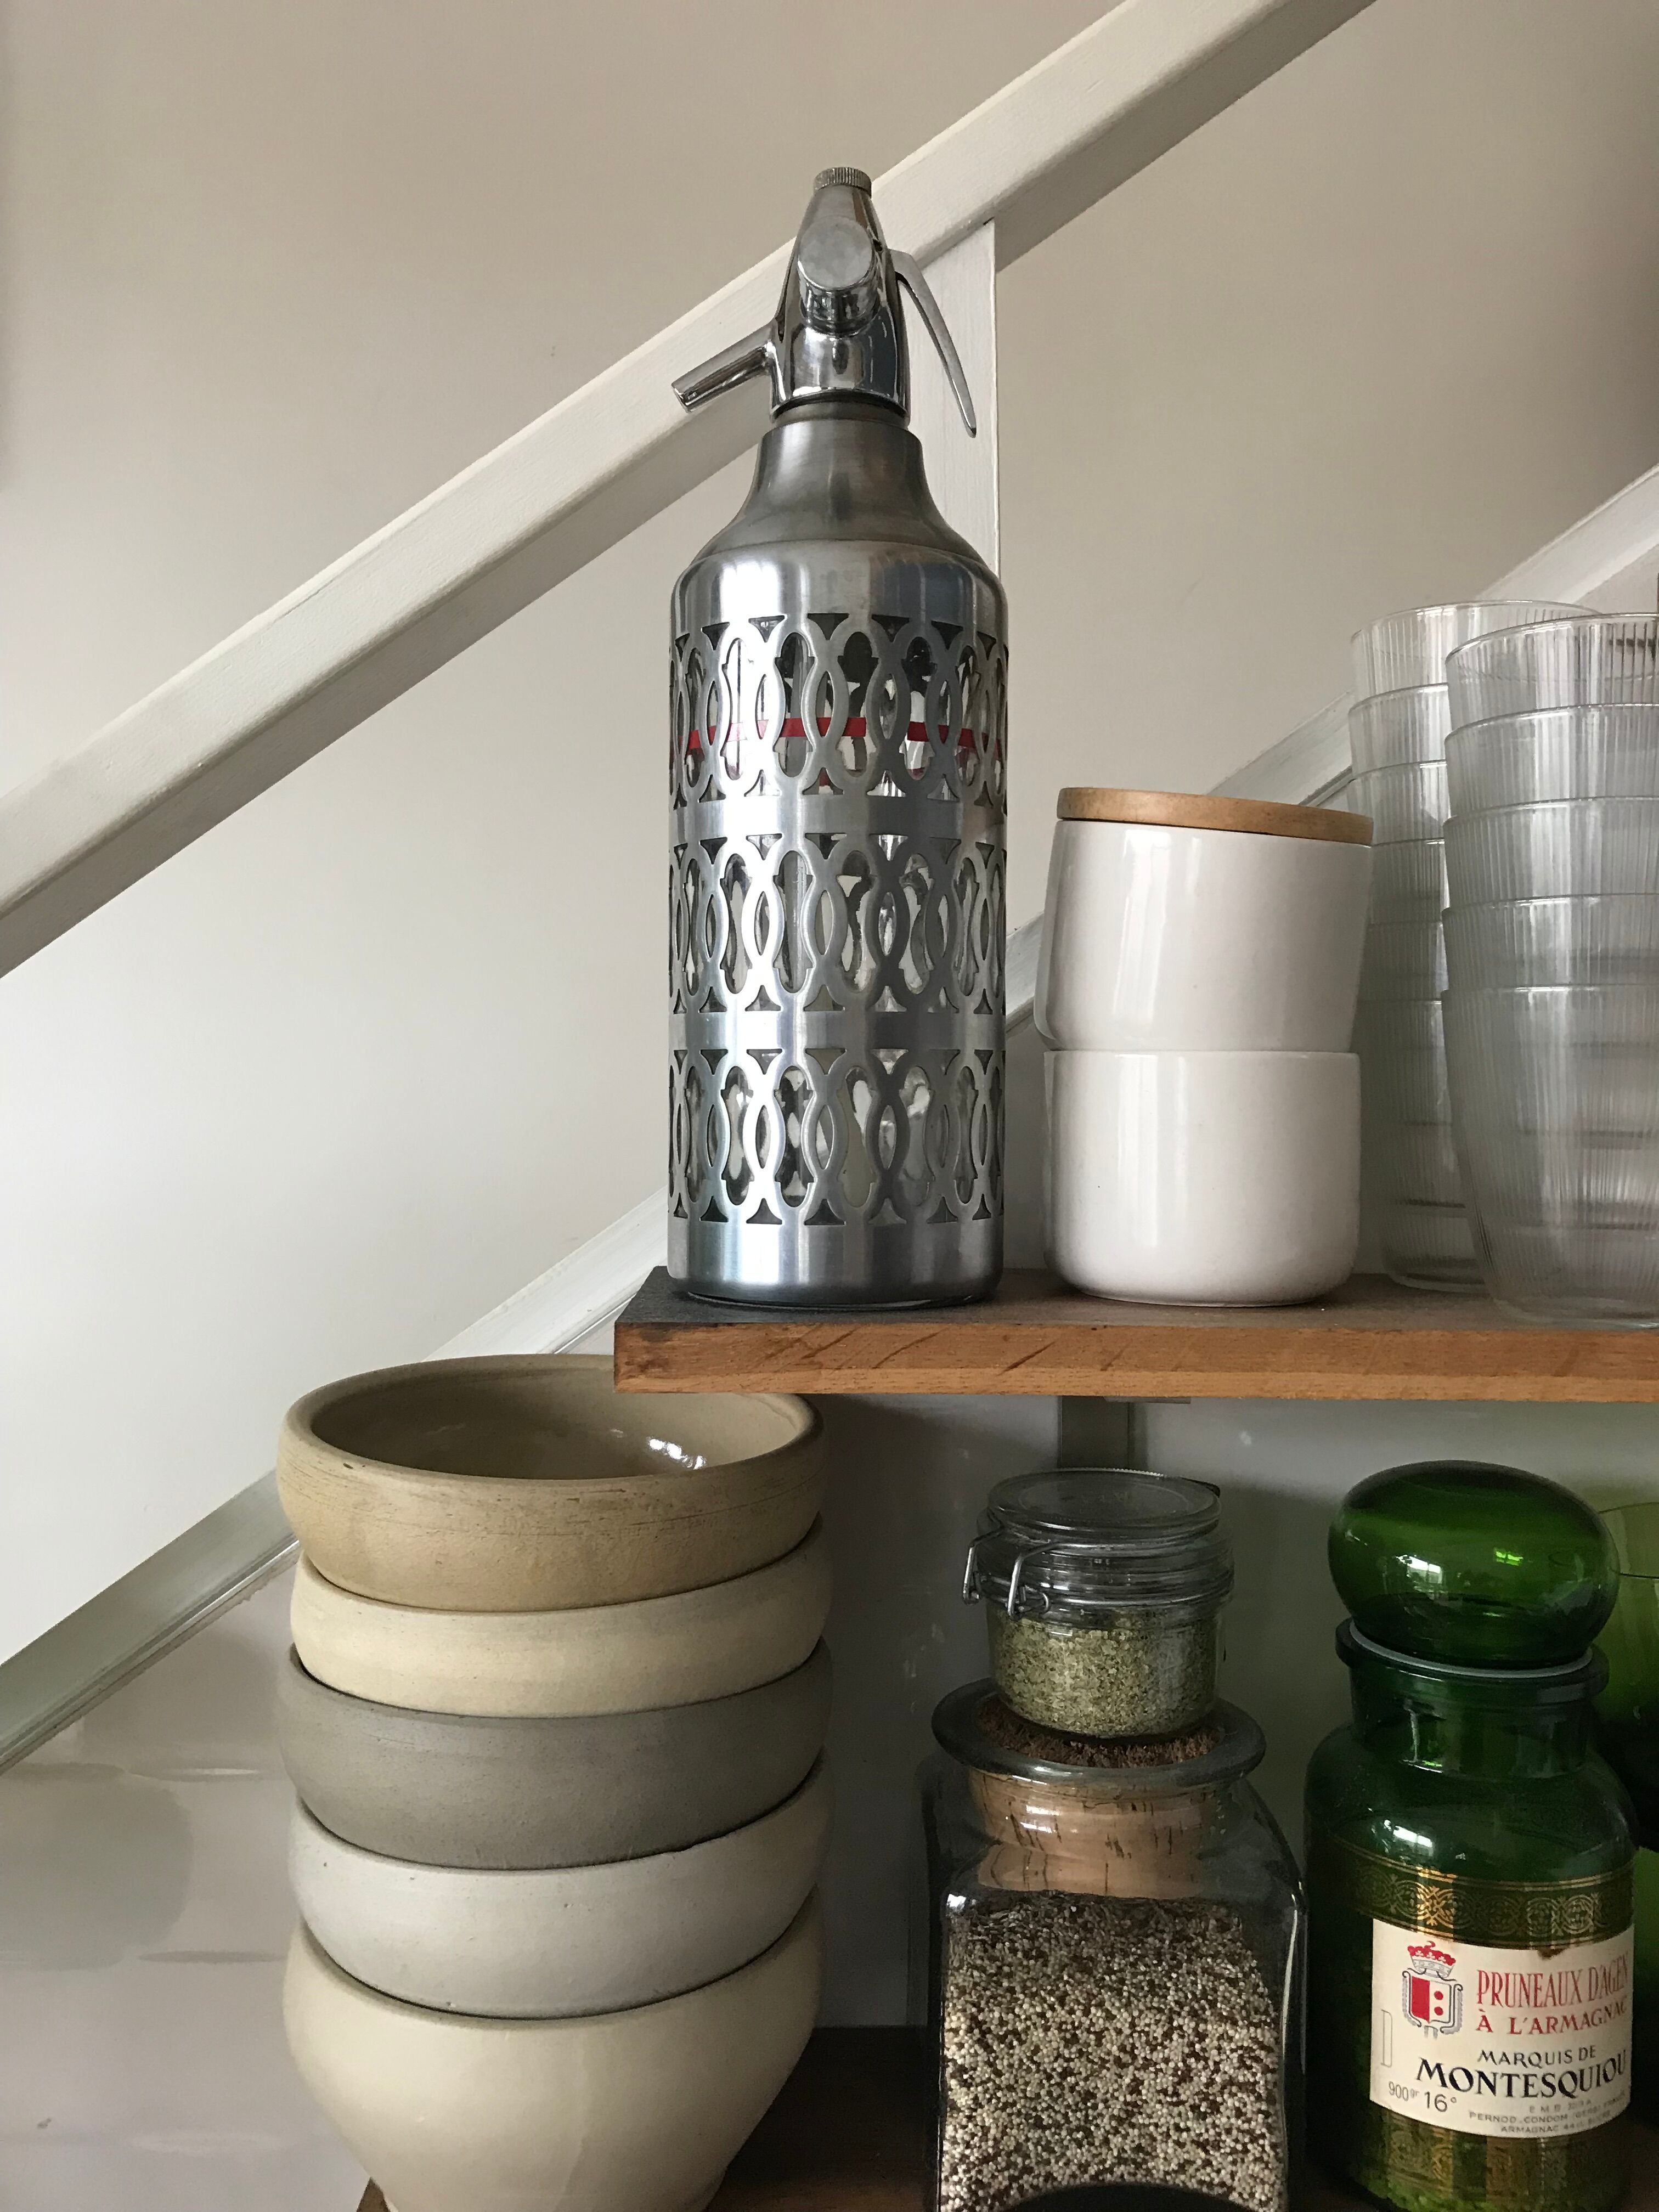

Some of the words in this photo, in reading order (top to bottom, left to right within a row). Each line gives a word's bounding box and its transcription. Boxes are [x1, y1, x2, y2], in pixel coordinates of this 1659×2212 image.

[1477, 1969, 1583, 2008] PRUNEAUX
[1475, 2008, 1494, 2033] À
[1508, 1995, 1628, 2035] L'ARMAGNAC
[1415, 2049, 1627, 2099] MONTESQUIOU
[1477, 2049, 1573, 2069] MARQUIS
[1578, 2045, 1597, 2062] DE
